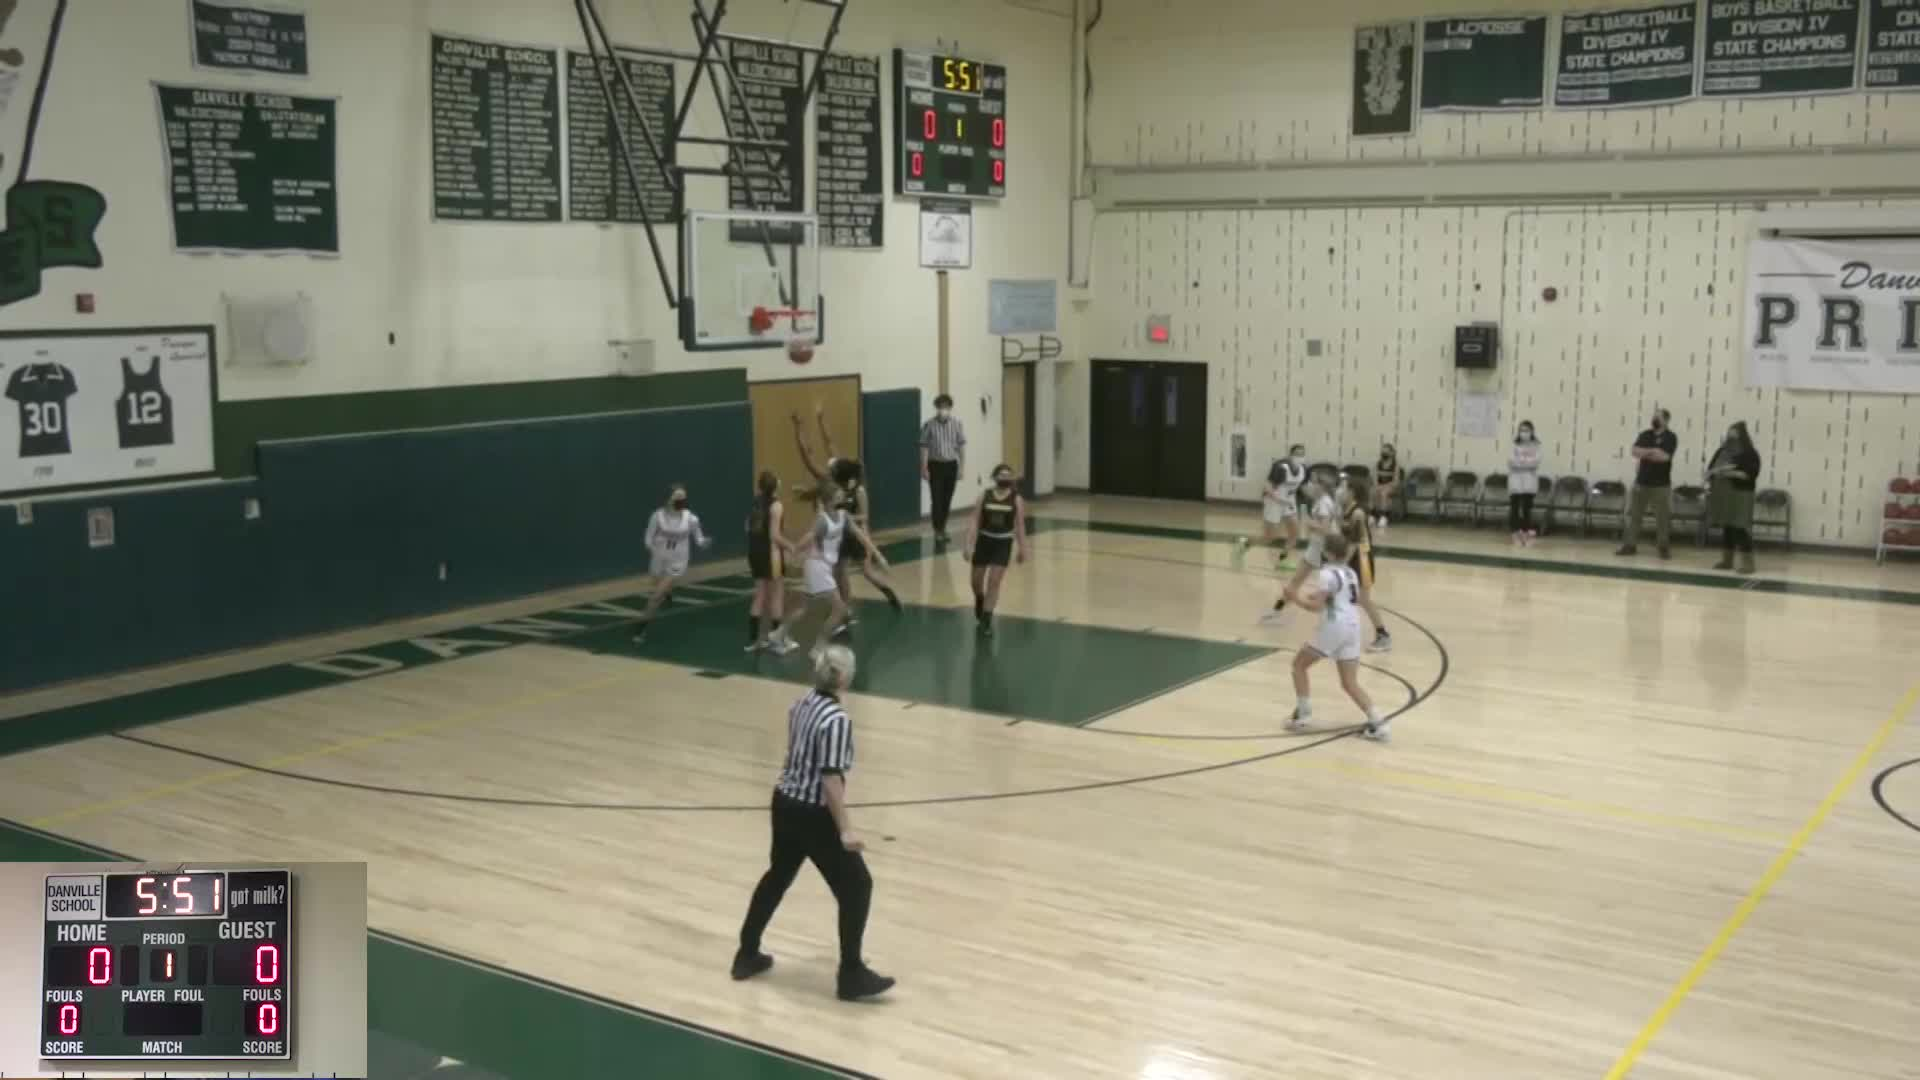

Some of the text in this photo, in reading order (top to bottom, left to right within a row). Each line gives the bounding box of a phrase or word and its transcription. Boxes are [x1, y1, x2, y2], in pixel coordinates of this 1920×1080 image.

[1604, 8, 1692, 30] BASKETBALL
[1712, 0, 1850, 18] BOYS BASKETBALL
[1446, 21, 1527, 35] LACROSSE
[1731, 16, 1829, 36] DIVISION IV
[1583, 30, 1669, 50] DIVISION IV
[1712, 34, 1846, 57] STATE CHAMPIONS
[1566, 47, 1685, 71] STATE CHAMPIONS
[924, 110, 936, 140] 0
[992, 118, 1004, 147] 0
[912, 153, 922, 176] 0
[993, 160, 1004, 182] 0
[24, 402, 61, 436] 30
[128, 391, 162, 425] 12
